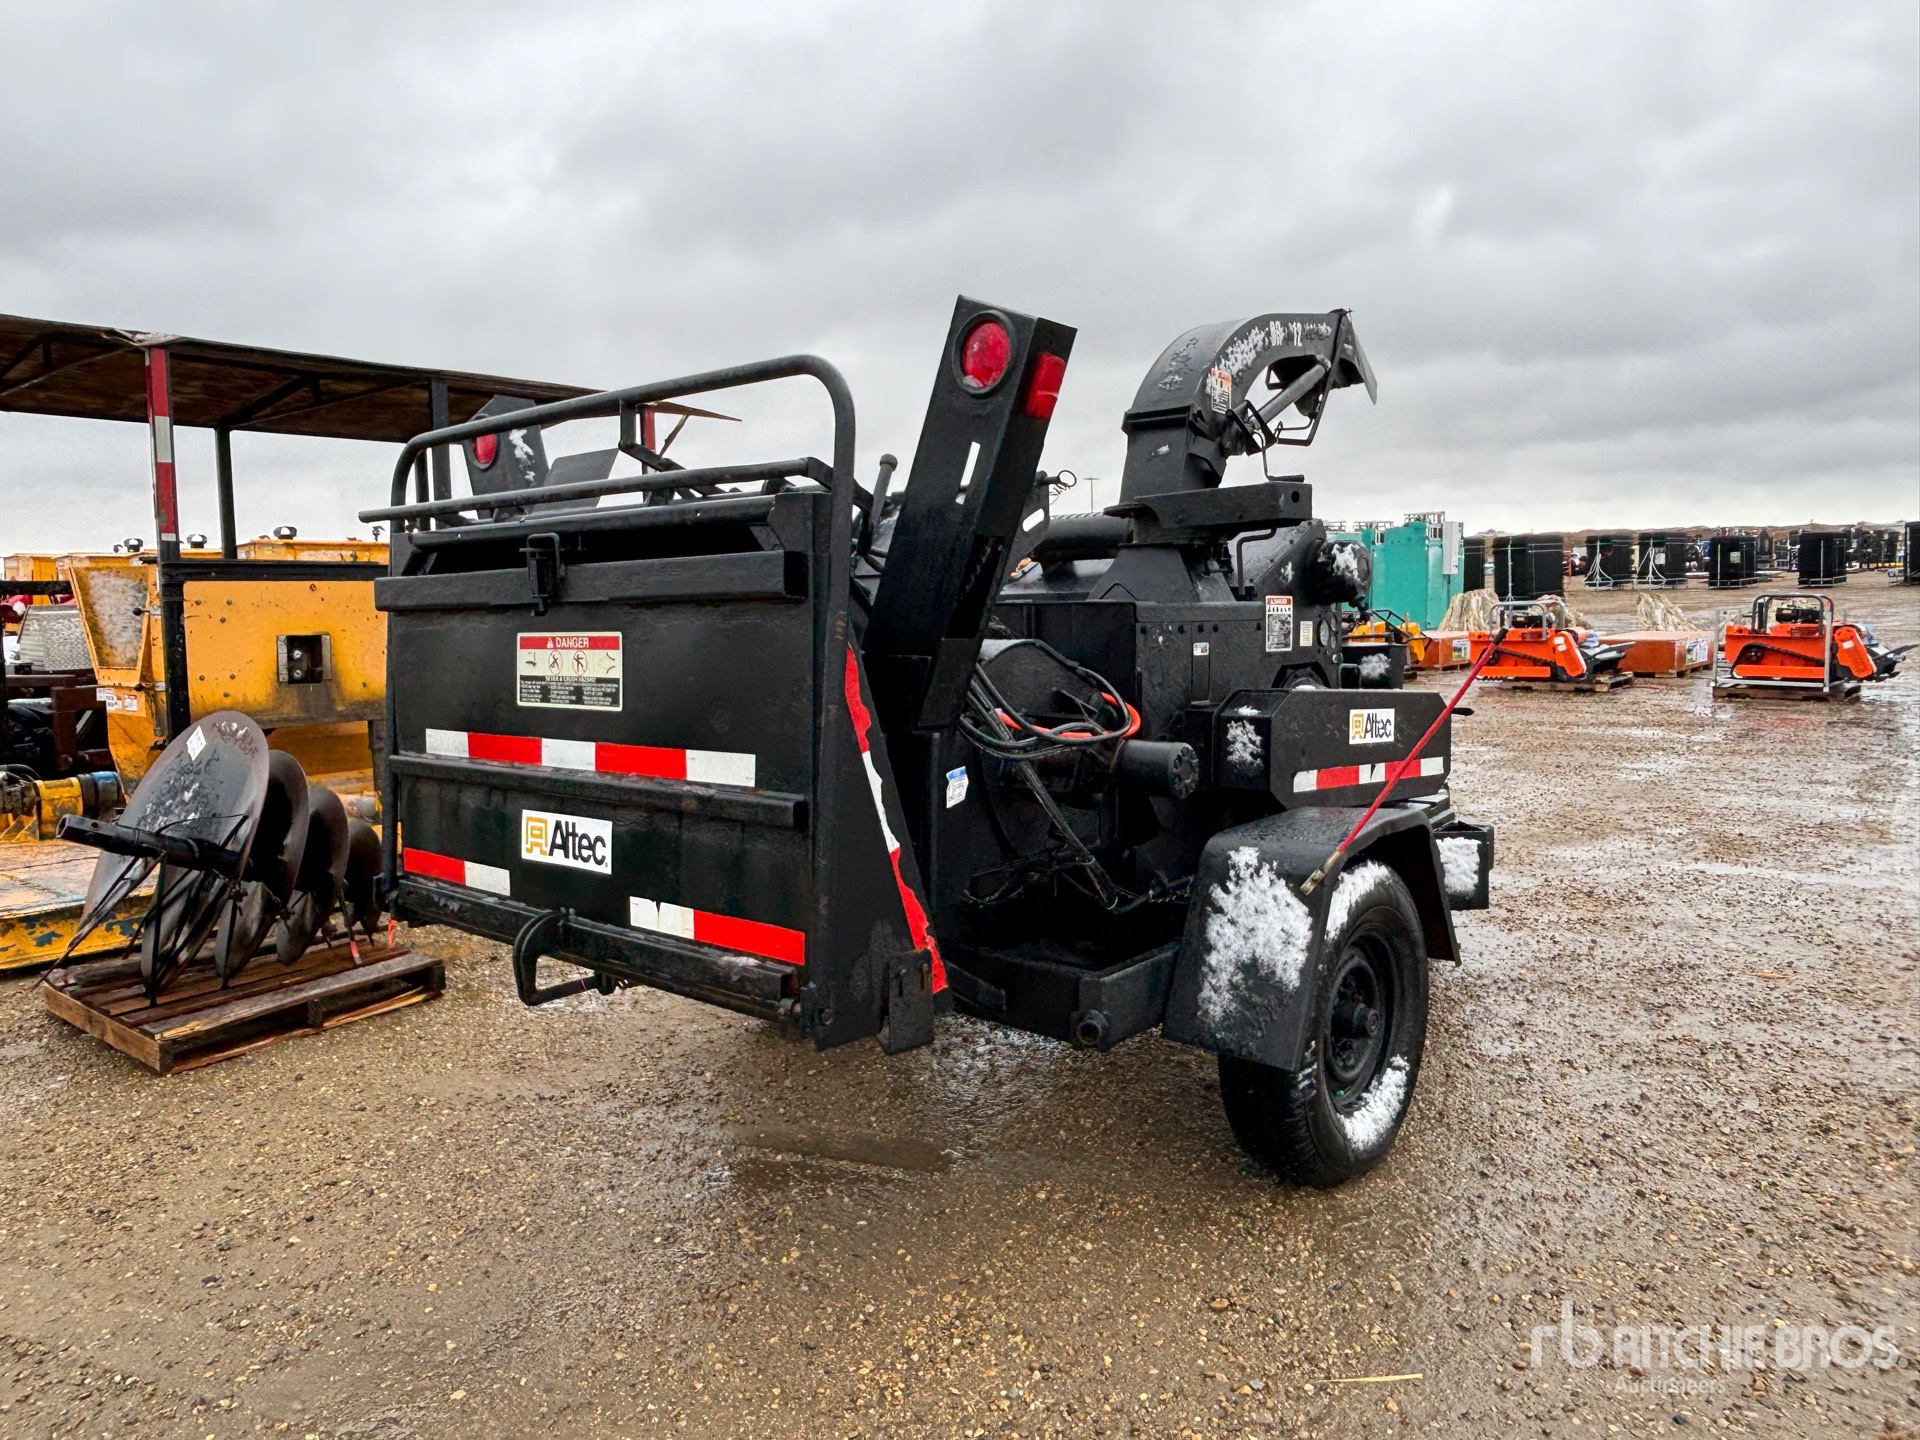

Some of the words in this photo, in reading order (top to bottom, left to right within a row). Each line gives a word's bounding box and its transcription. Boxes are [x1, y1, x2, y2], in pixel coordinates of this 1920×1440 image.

[556, 637, 589, 649] DANGER
[1364, 712, 1392, 739] Altec
[548, 819, 607, 866] Altec
